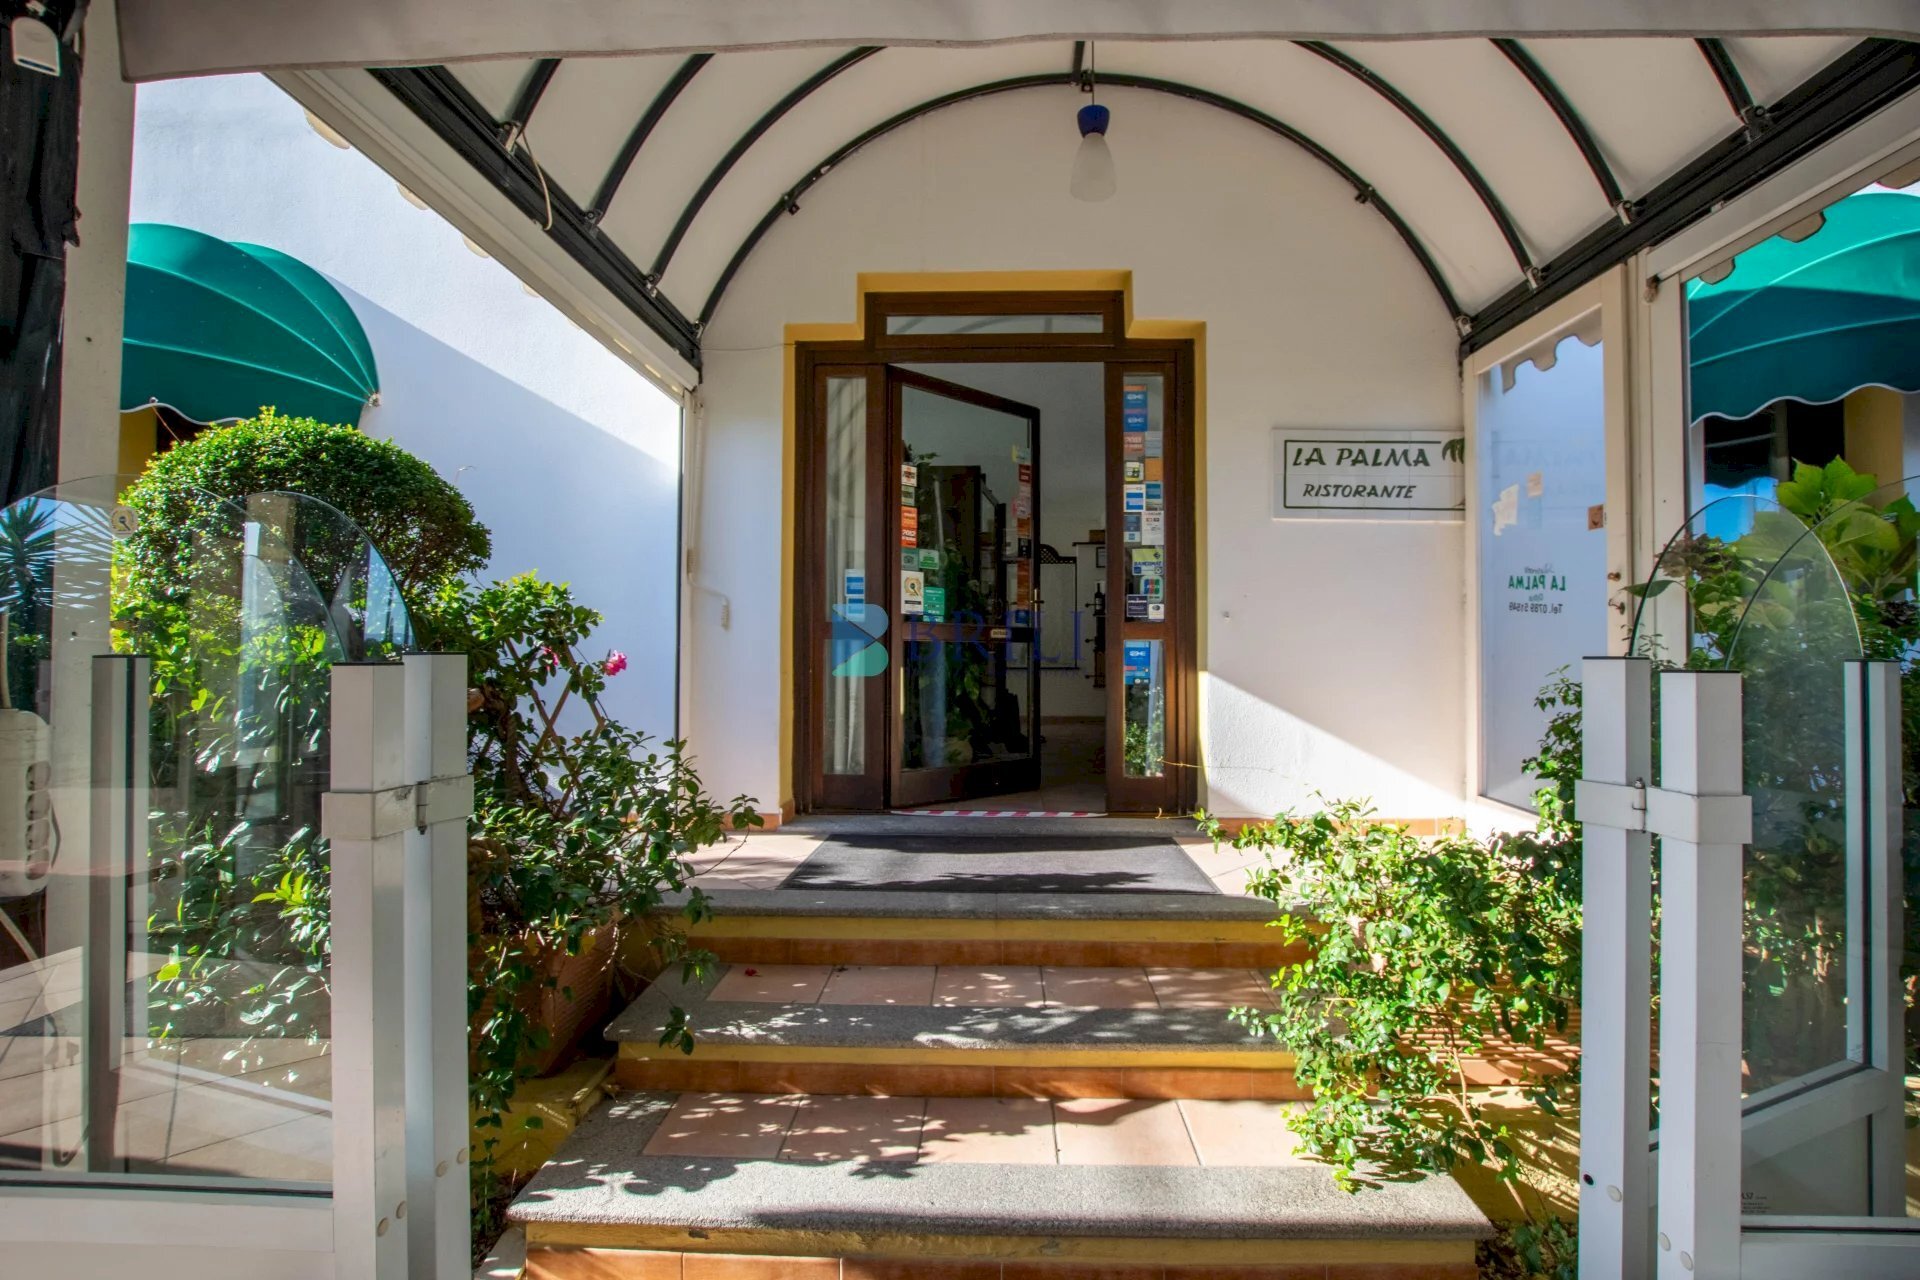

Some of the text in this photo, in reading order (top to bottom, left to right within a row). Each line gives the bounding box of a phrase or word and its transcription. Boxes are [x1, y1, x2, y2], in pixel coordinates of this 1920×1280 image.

[1292, 447, 1431, 467] LA PALMA
[1302, 483, 1418, 499] RISTORANTE
